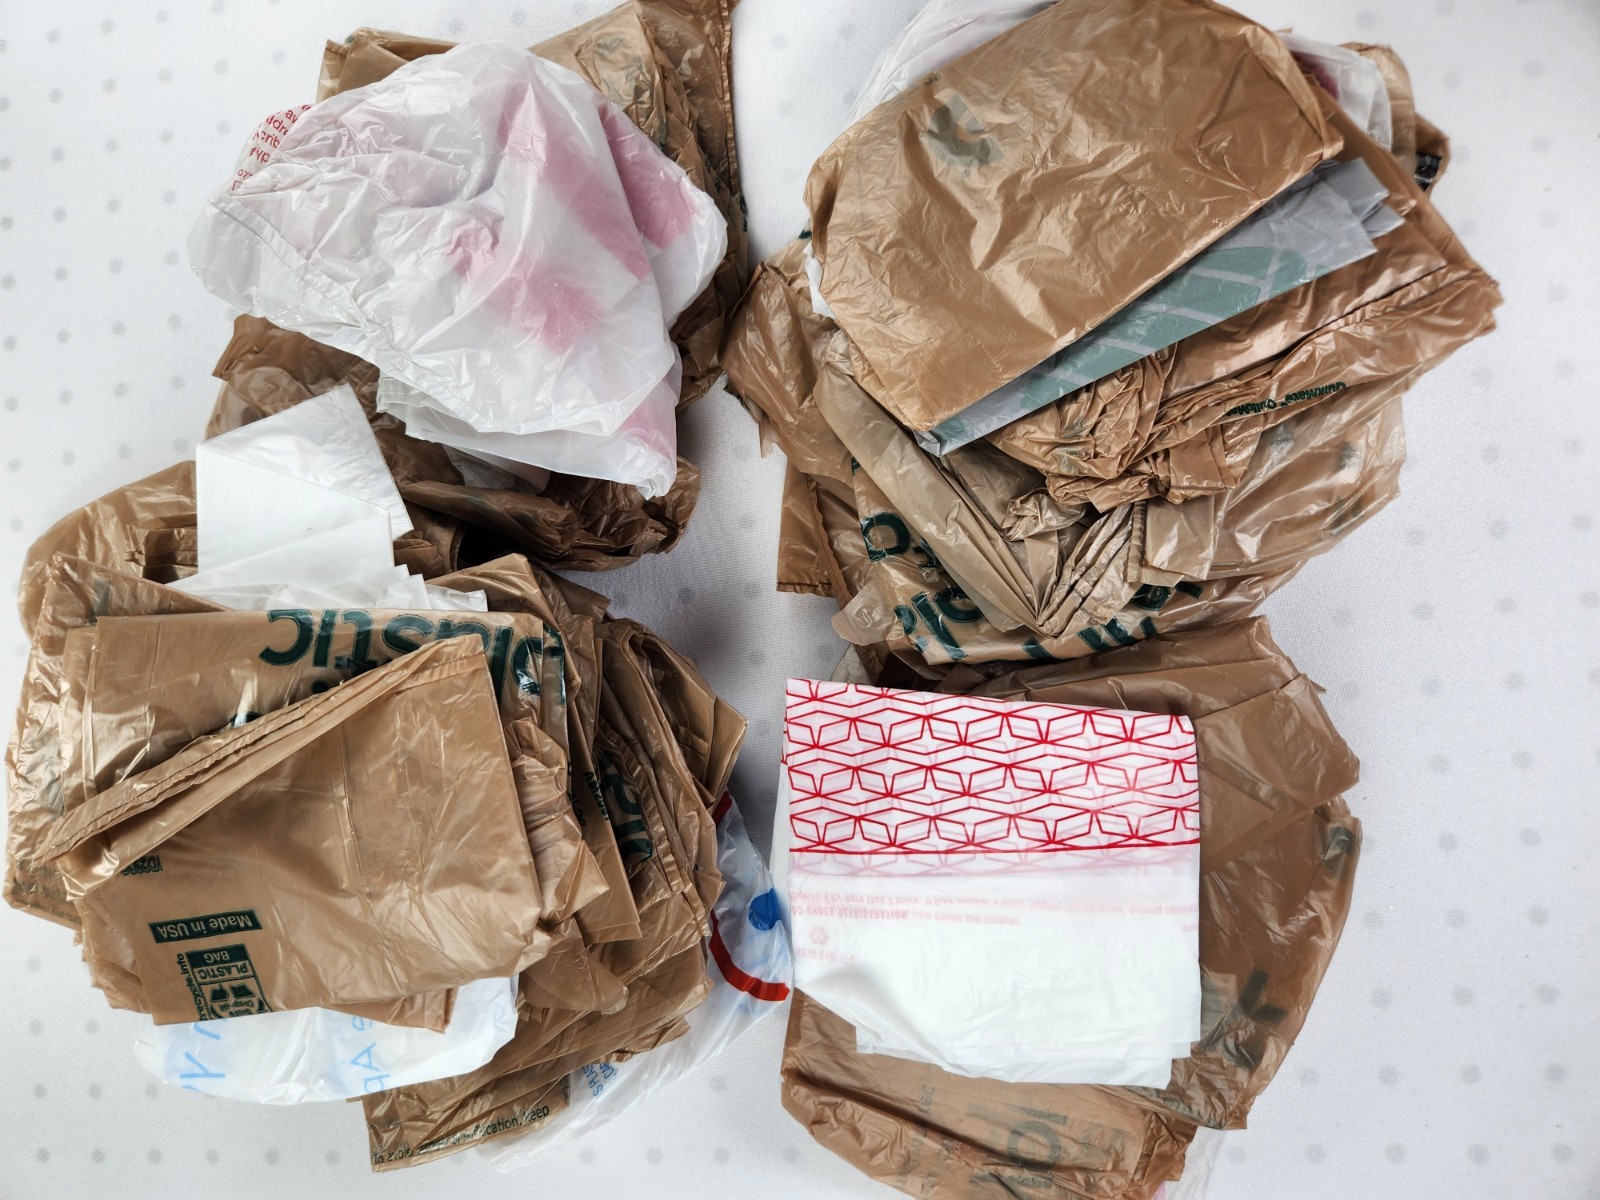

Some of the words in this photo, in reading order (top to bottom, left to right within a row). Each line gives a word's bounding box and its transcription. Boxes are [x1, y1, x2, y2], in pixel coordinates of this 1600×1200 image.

[156, 922, 190, 939] USA
[190, 919, 207, 934] in
[208, 914, 252, 931] Made
[202, 950, 230, 963] BAG
[197, 962, 248, 981] PLASTIC
